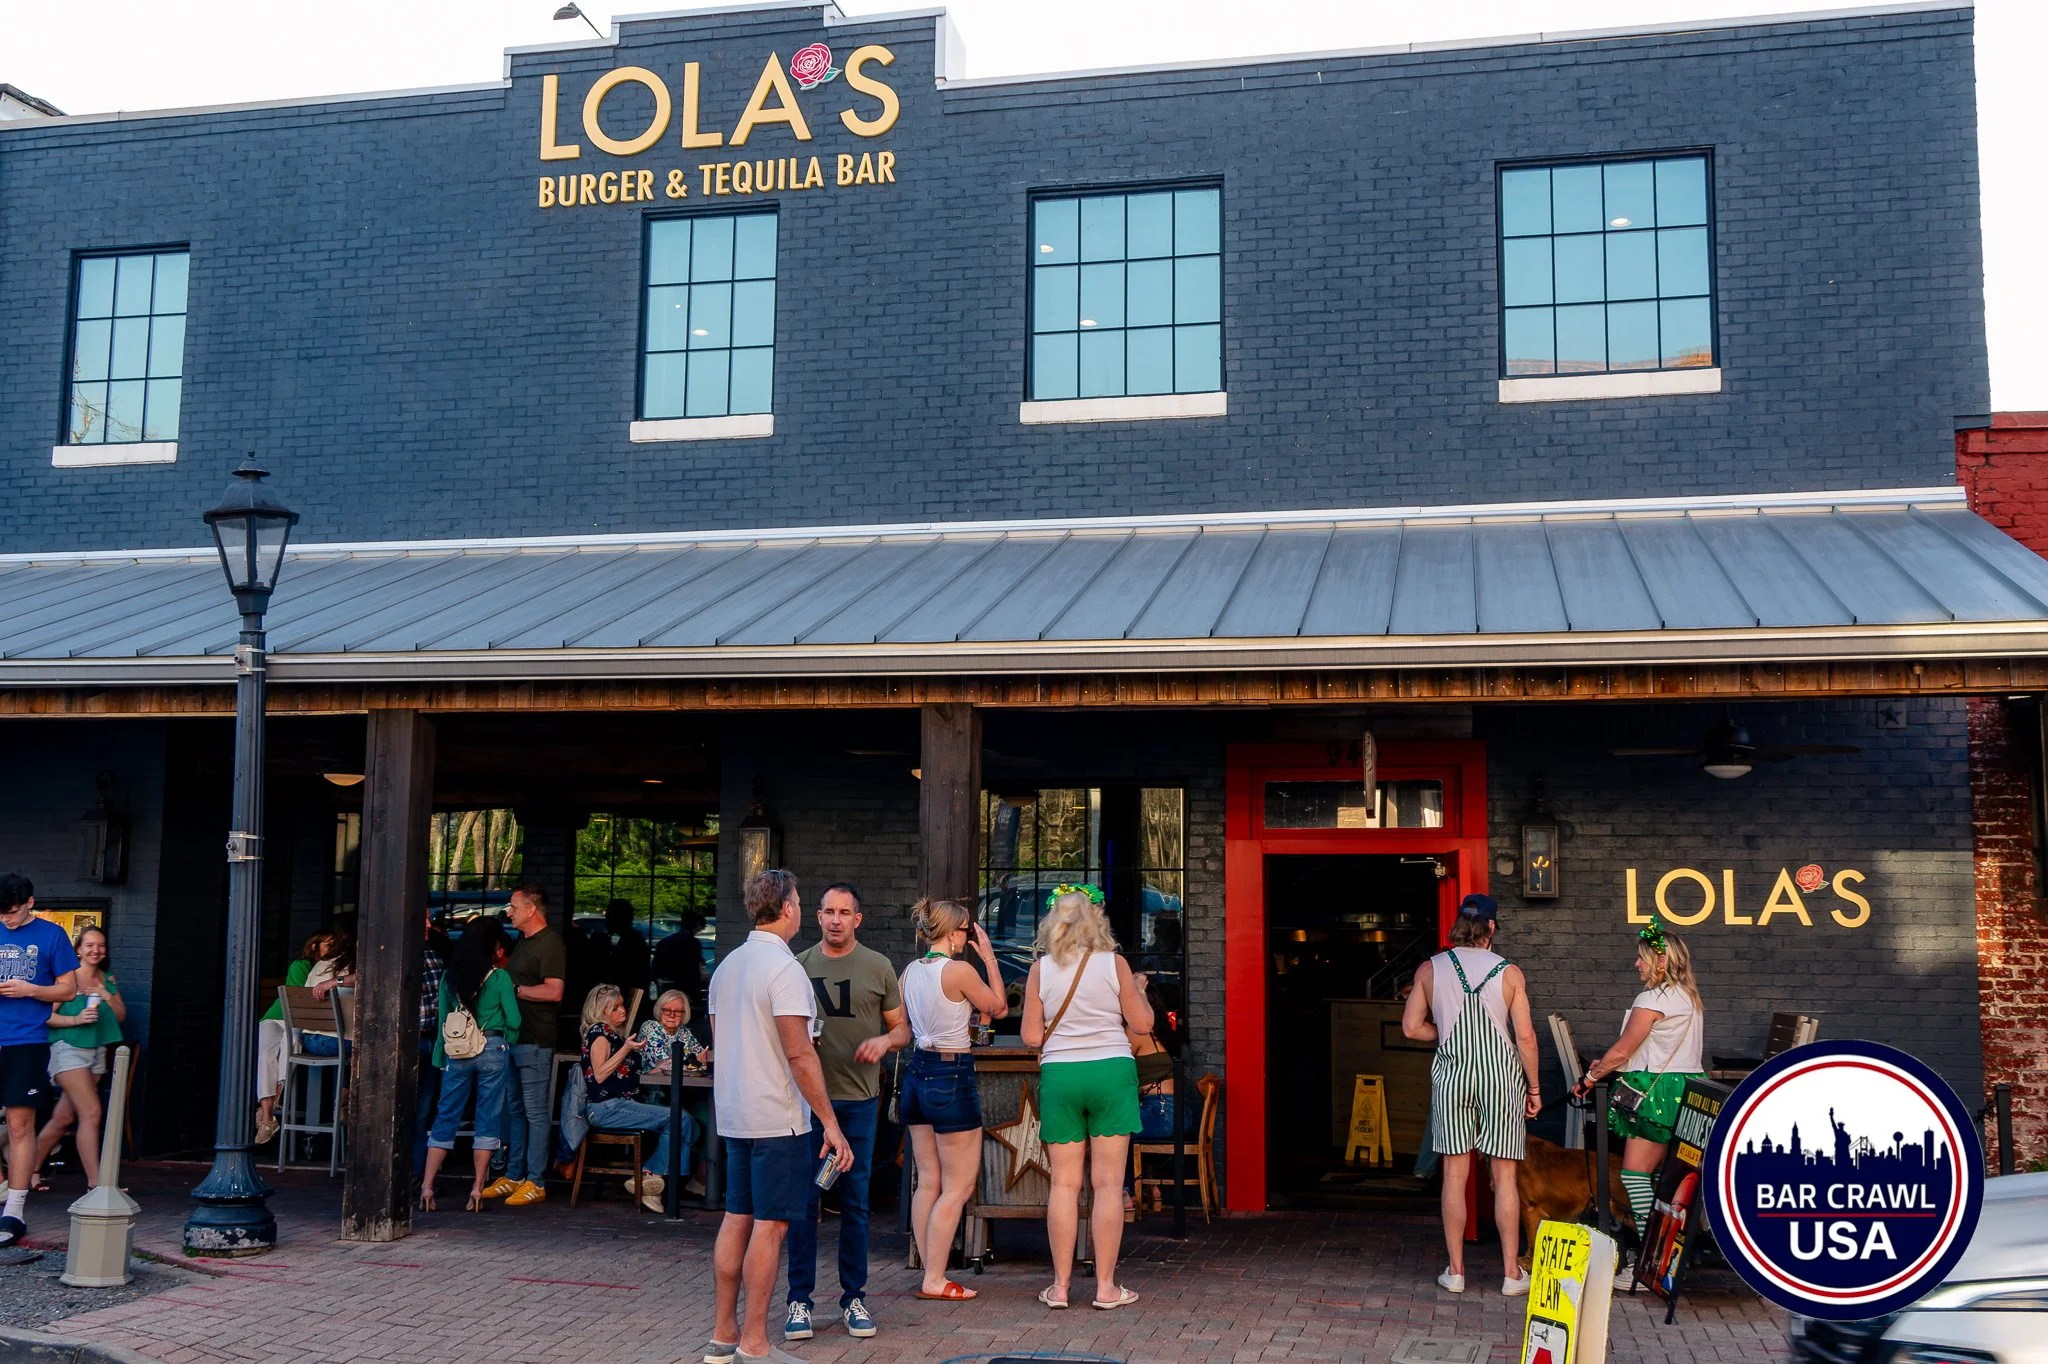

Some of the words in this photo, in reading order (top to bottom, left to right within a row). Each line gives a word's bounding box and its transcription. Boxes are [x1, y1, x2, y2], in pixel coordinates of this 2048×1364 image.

[539, 169, 655, 208] BURGER
[665, 169, 688, 199] &
[699, 156, 824, 196] TEQUILA
[837, 151, 896, 187] BAR
[1675, 1106, 1716, 1148] MADNES
[1540, 1235, 1577, 1271] STATE
[1540, 1277, 1561, 1311] LAW
